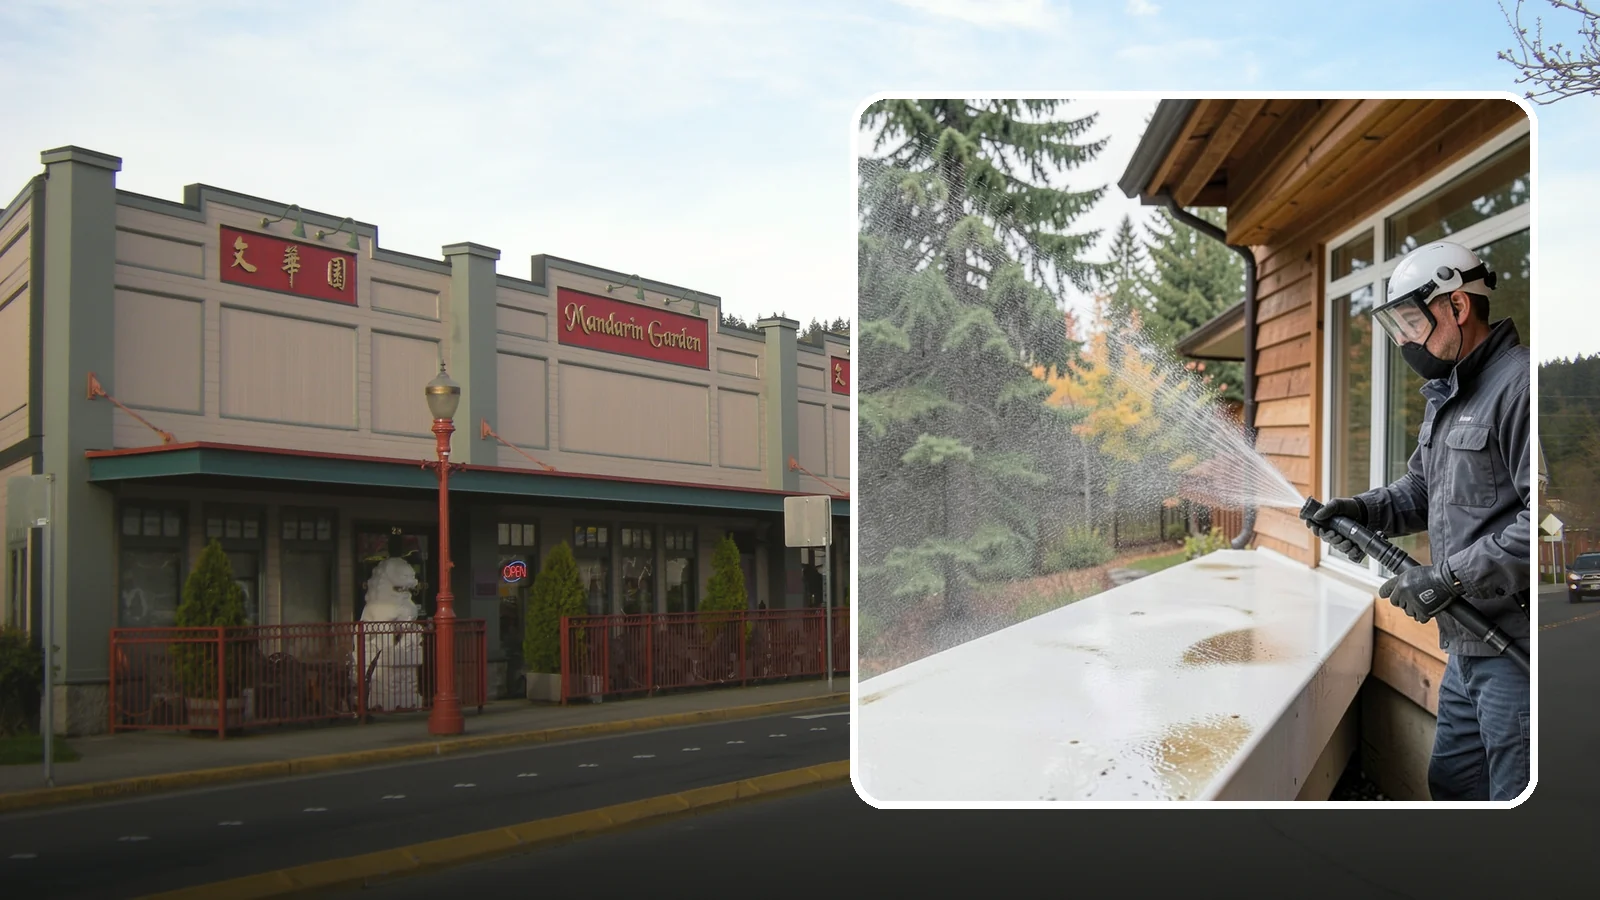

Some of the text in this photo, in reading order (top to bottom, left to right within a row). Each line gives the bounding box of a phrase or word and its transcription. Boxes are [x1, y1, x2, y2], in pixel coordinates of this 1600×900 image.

[231, 236, 346, 291] 文華園
[565, 302, 701, 352] Mandarin Garden
[503, 565, 526, 578] OPEN
